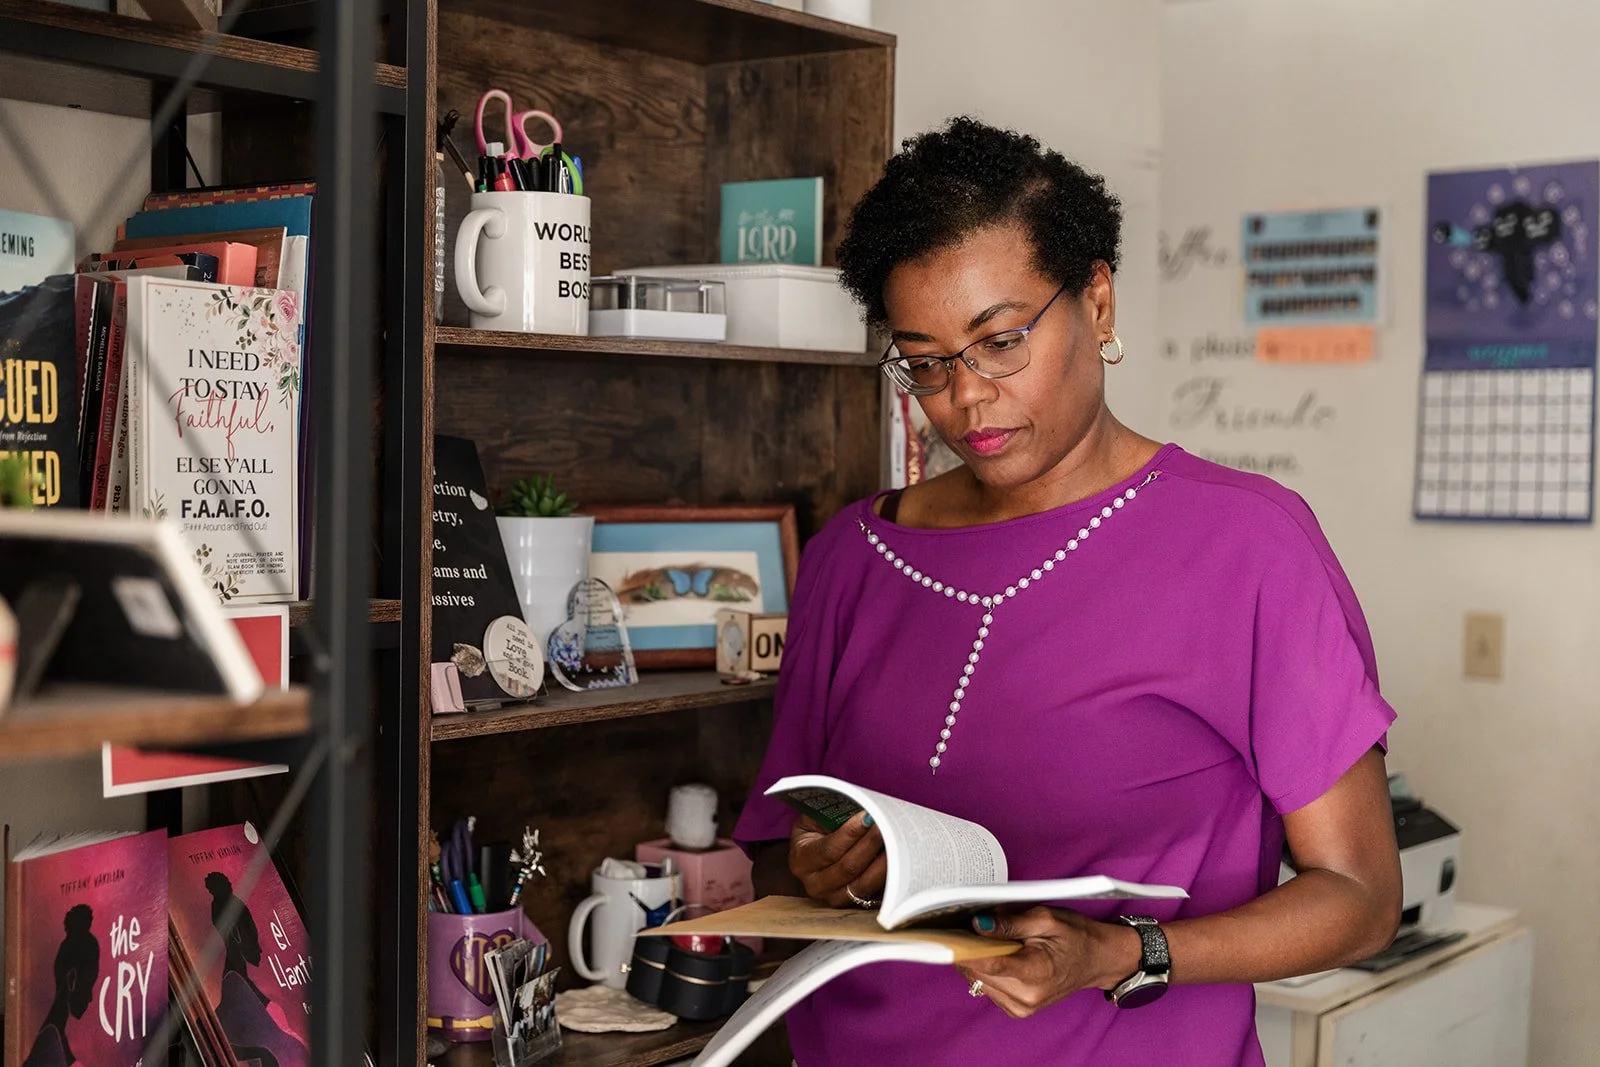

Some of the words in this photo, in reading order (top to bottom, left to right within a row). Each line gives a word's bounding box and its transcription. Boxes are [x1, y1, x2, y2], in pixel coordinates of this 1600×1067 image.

[0, 232, 34, 257] EMING
[738, 225, 797, 263] LORD
[188, 349, 194, 368] I
[199, 349, 260, 372] NEED
[180, 378, 211, 399] TO
[215, 379, 268, 400] STAY
[168, 384, 275, 461] Faithful,
[17, 431, 47, 443] Rejection
[116, 429, 127, 460] Pages
[176, 457, 221, 474] ELSE
[224, 458, 274, 474] Y'ALL
[193, 479, 257, 495] GONNA
[181, 499, 270, 518] F.A.A.F.O.
[202, 522, 226, 532] Around
[227, 522, 239, 531] and
[240, 521, 253, 531] Find
[432, 566, 460, 579] ams
[462, 564, 488, 579] and
[59, 875, 91, 897] TIFFANY
[110, 914, 141, 959] the
[269, 909, 292, 951] el
[98, 950, 154, 1044] CRY
